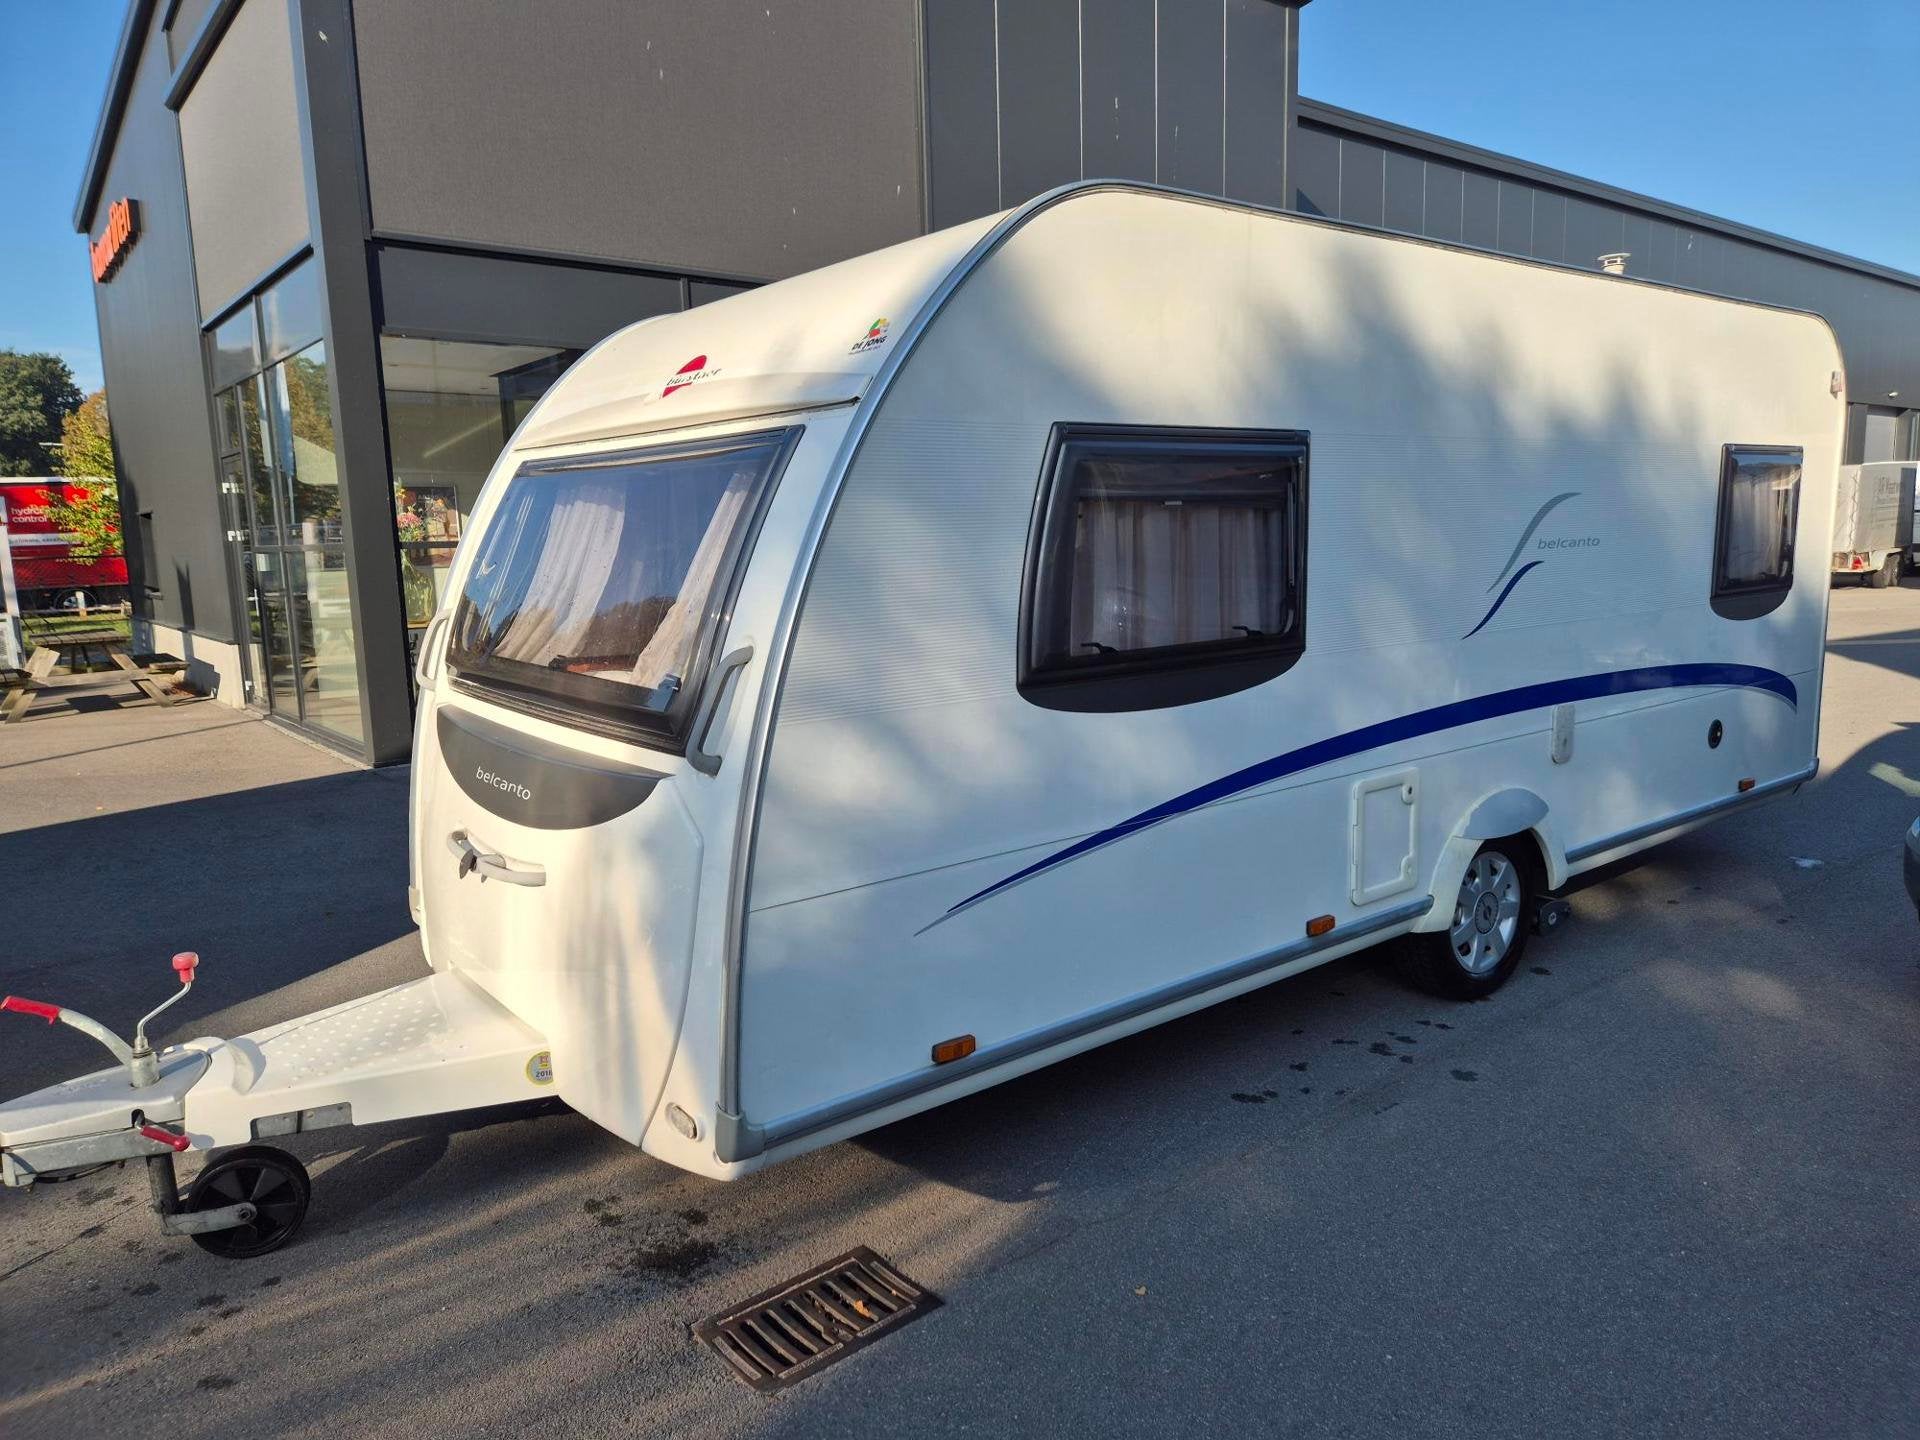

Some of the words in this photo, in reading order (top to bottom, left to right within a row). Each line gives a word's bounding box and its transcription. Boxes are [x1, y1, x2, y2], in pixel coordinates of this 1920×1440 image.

[12, 514, 48, 523] control
[1537, 537, 1601, 550] belcanto
[476, 765, 531, 801] belcanto
